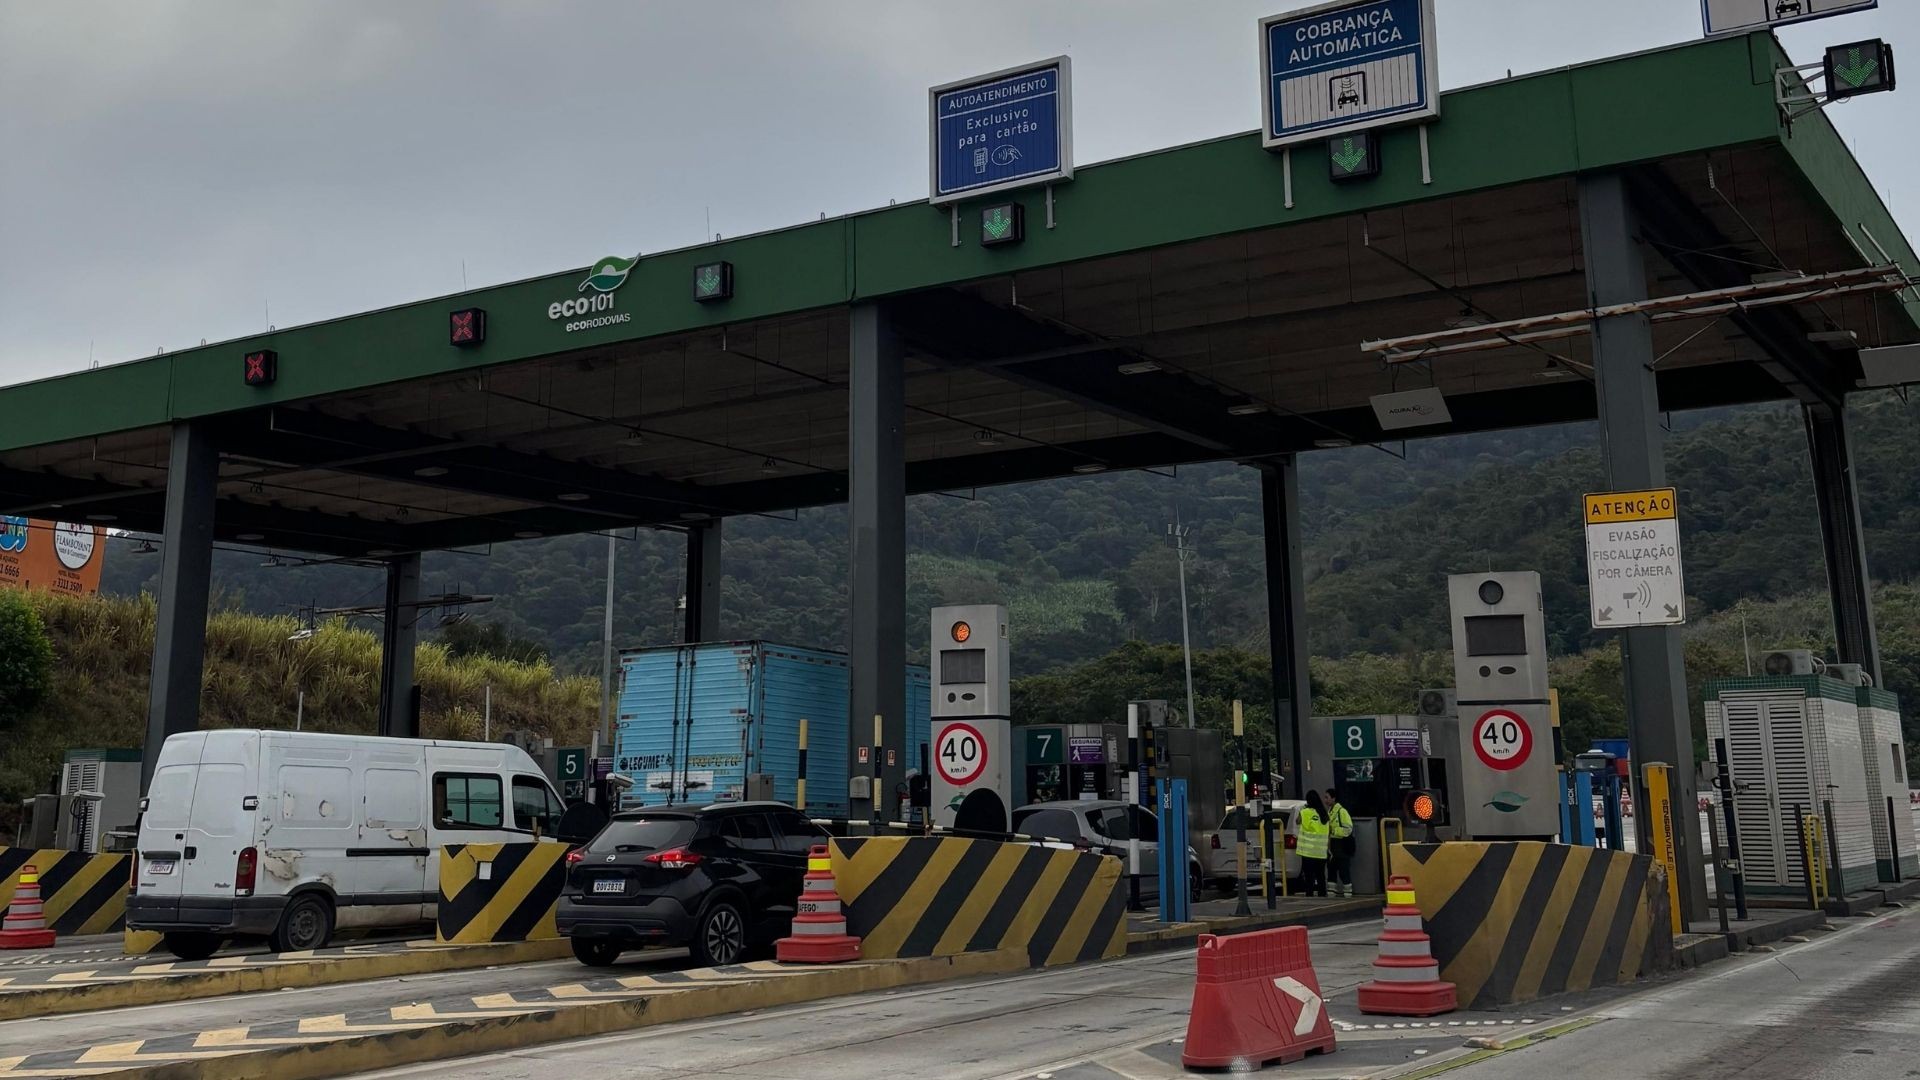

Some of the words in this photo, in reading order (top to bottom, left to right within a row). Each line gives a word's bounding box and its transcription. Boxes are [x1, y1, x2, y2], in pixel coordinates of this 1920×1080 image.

[1295, 8, 1393, 42] COBRANÇA
[1288, 26, 1402, 64] AUTOMÁTICA
[948, 78, 1047, 110] AUTOATENDIMENTO
[966, 108, 1029, 130] Exclusivo
[959, 133, 986, 149] para
[996, 121, 1037, 139] cartão
[548, 292, 615, 320] eco101
[566, 313, 631, 332] ecoRODOVIAS
[1591, 495, 1670, 515] ATENÇÃO
[1608, 527, 1656, 542] EVASÃO
[1593, 544, 1675, 561] FISCALIZAÇÃO
[1597, 568, 1621, 579] POR
[1625, 564, 1673, 578] CÂMERA
[1347, 725, 1364, 751] 8
[1482, 721, 1518, 744] 40
[942, 736, 976, 762] 40
[1037, 734, 1052, 758] 7
[565, 754, 577, 774] 5
